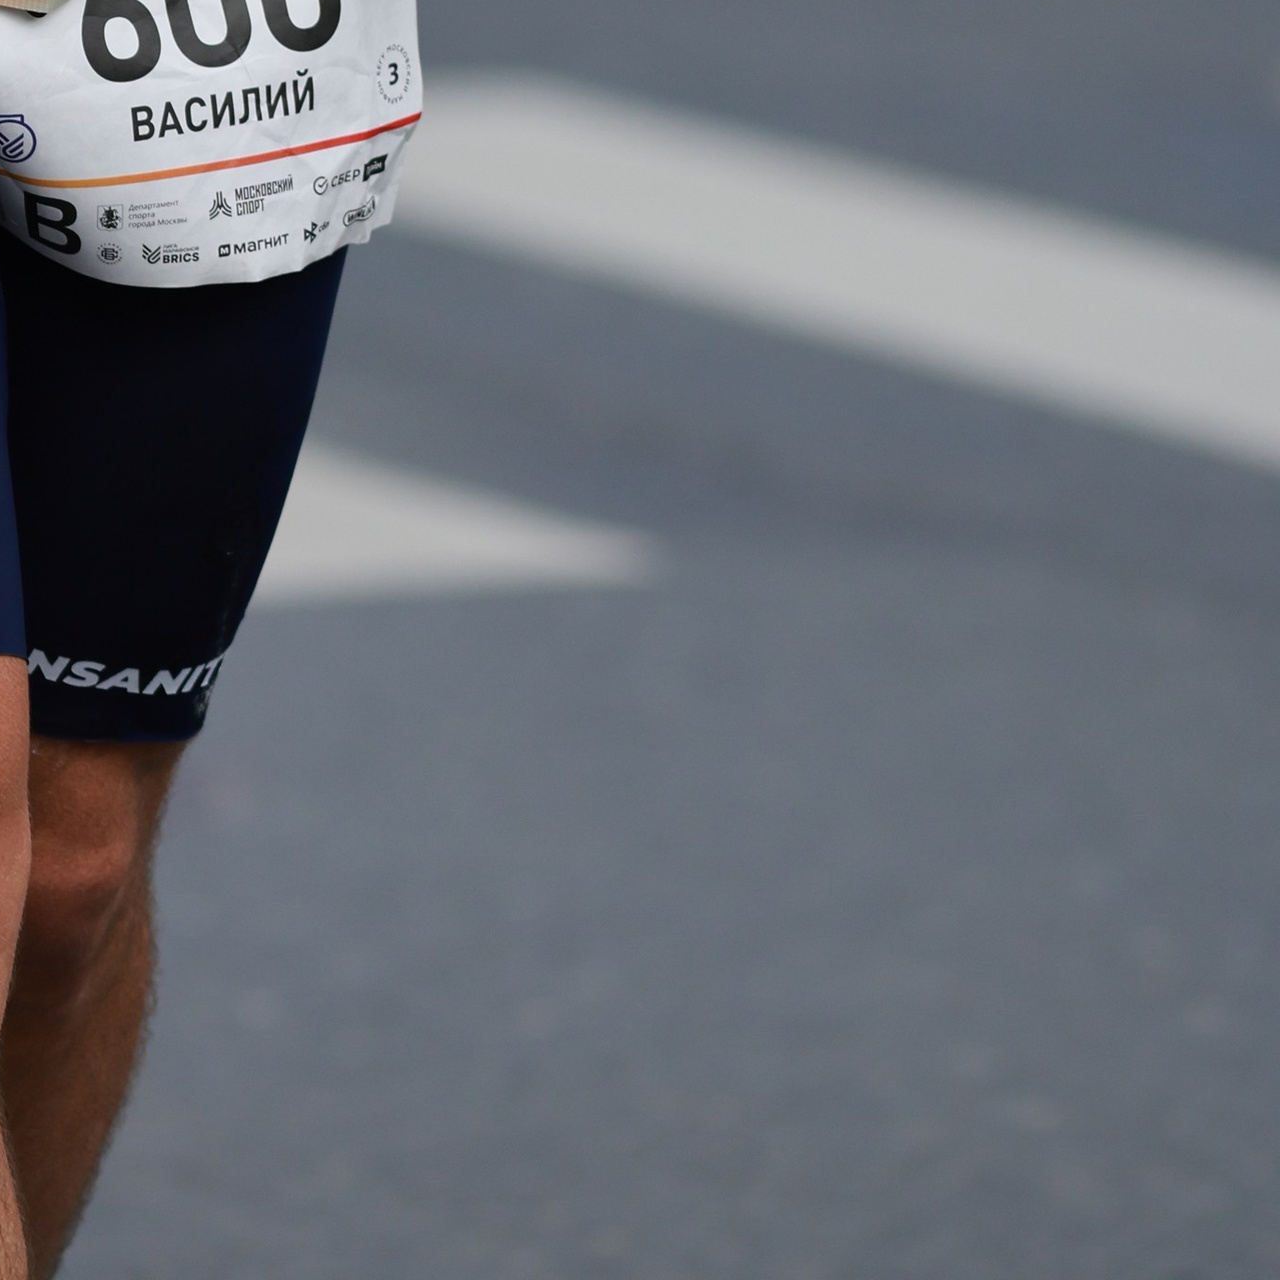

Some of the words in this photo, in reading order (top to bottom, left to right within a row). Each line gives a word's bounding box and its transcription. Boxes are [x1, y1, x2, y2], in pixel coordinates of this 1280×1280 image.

[388, 62, 399, 86] 3
[130, 68, 315, 142] ВАСИЛИЙ
[234, 173, 294, 202] МОСКОВСКИЙ
[330, 168, 361, 188] СБЕР
[128, 200, 180, 213] Департамент
[128, 211, 156, 221] спорта
[235, 198, 265, 216] СПОРТ
[128, 220, 156, 229] города
[157, 217, 188, 227] Москвы
[163, 252, 200, 264] BRICS
[27, 647, 225, 696] NSANIT
